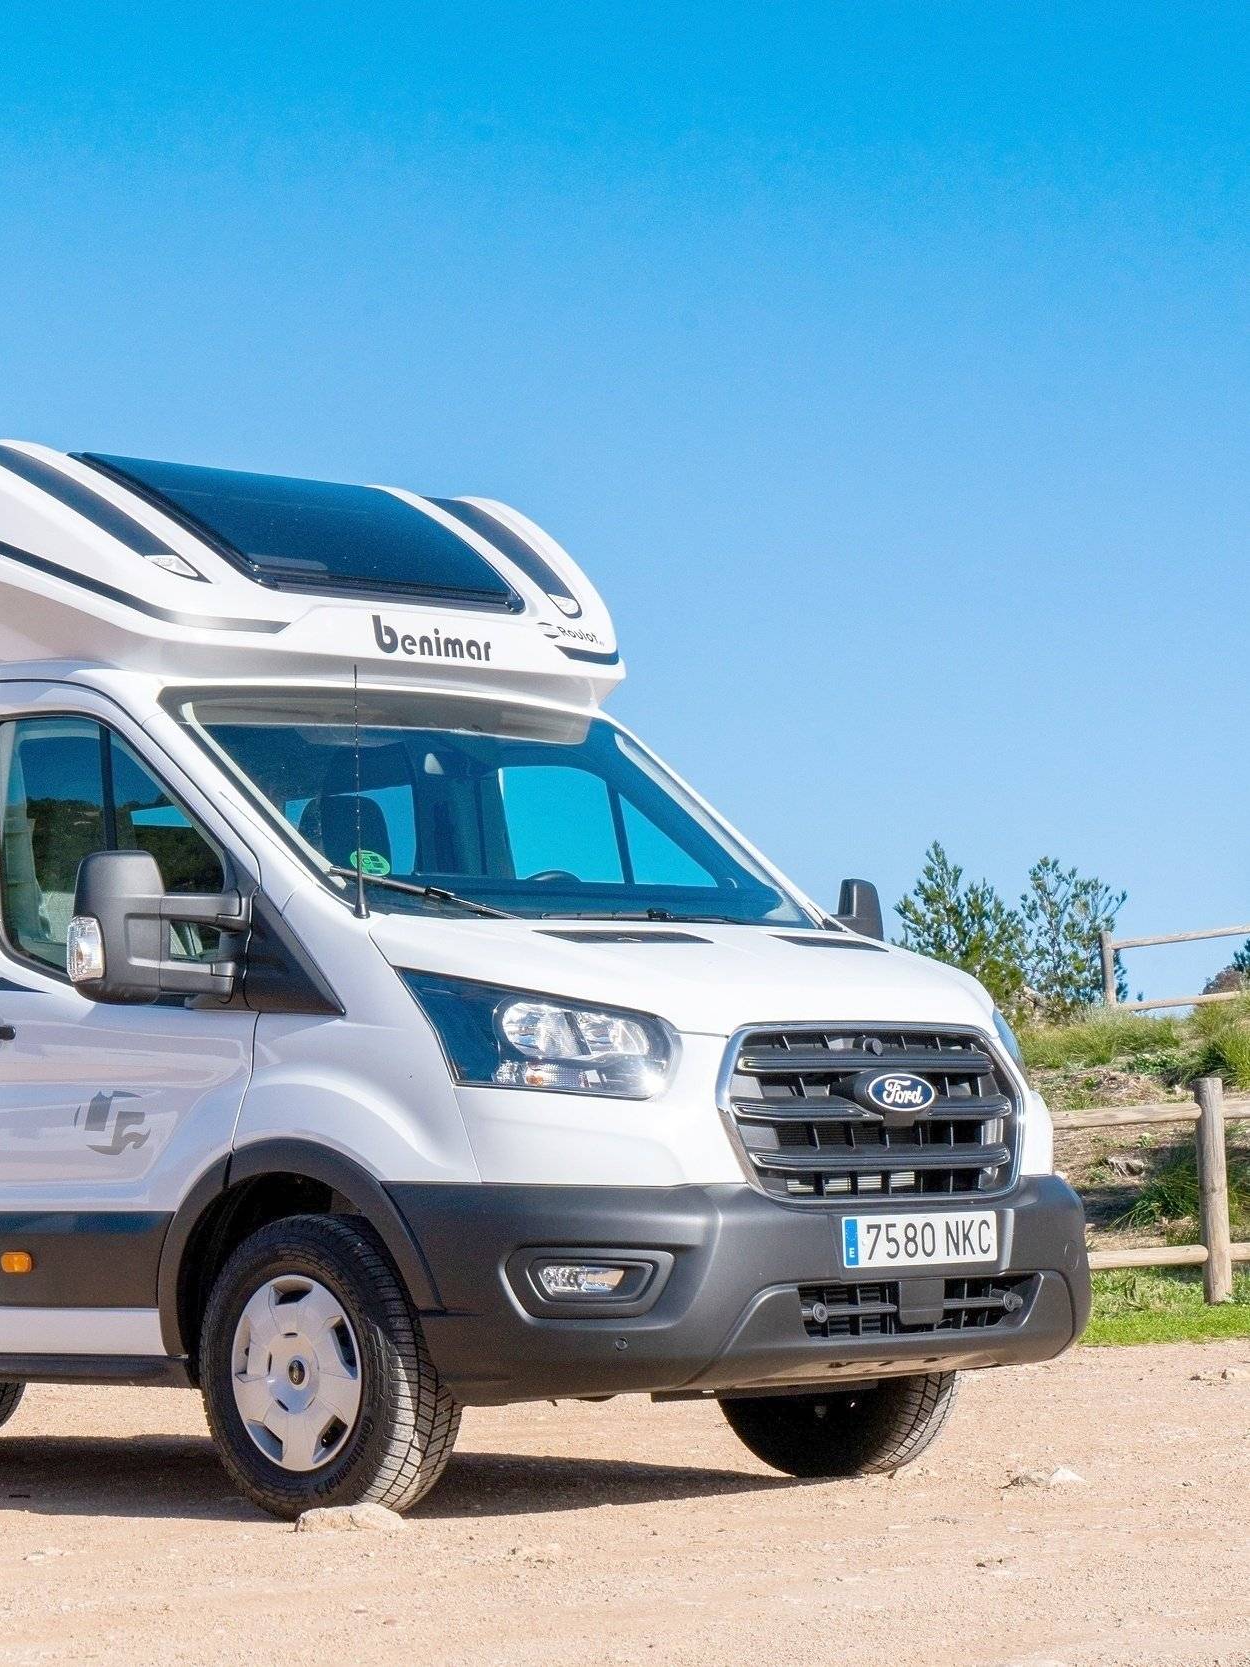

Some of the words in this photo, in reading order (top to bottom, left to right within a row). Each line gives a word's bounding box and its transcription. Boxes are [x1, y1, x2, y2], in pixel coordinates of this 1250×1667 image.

[371, 614, 491, 661] benimar
[883, 1079, 923, 1104] Ford
[866, 1222, 936, 1260] 7580
[945, 1219, 991, 1257] NKC
